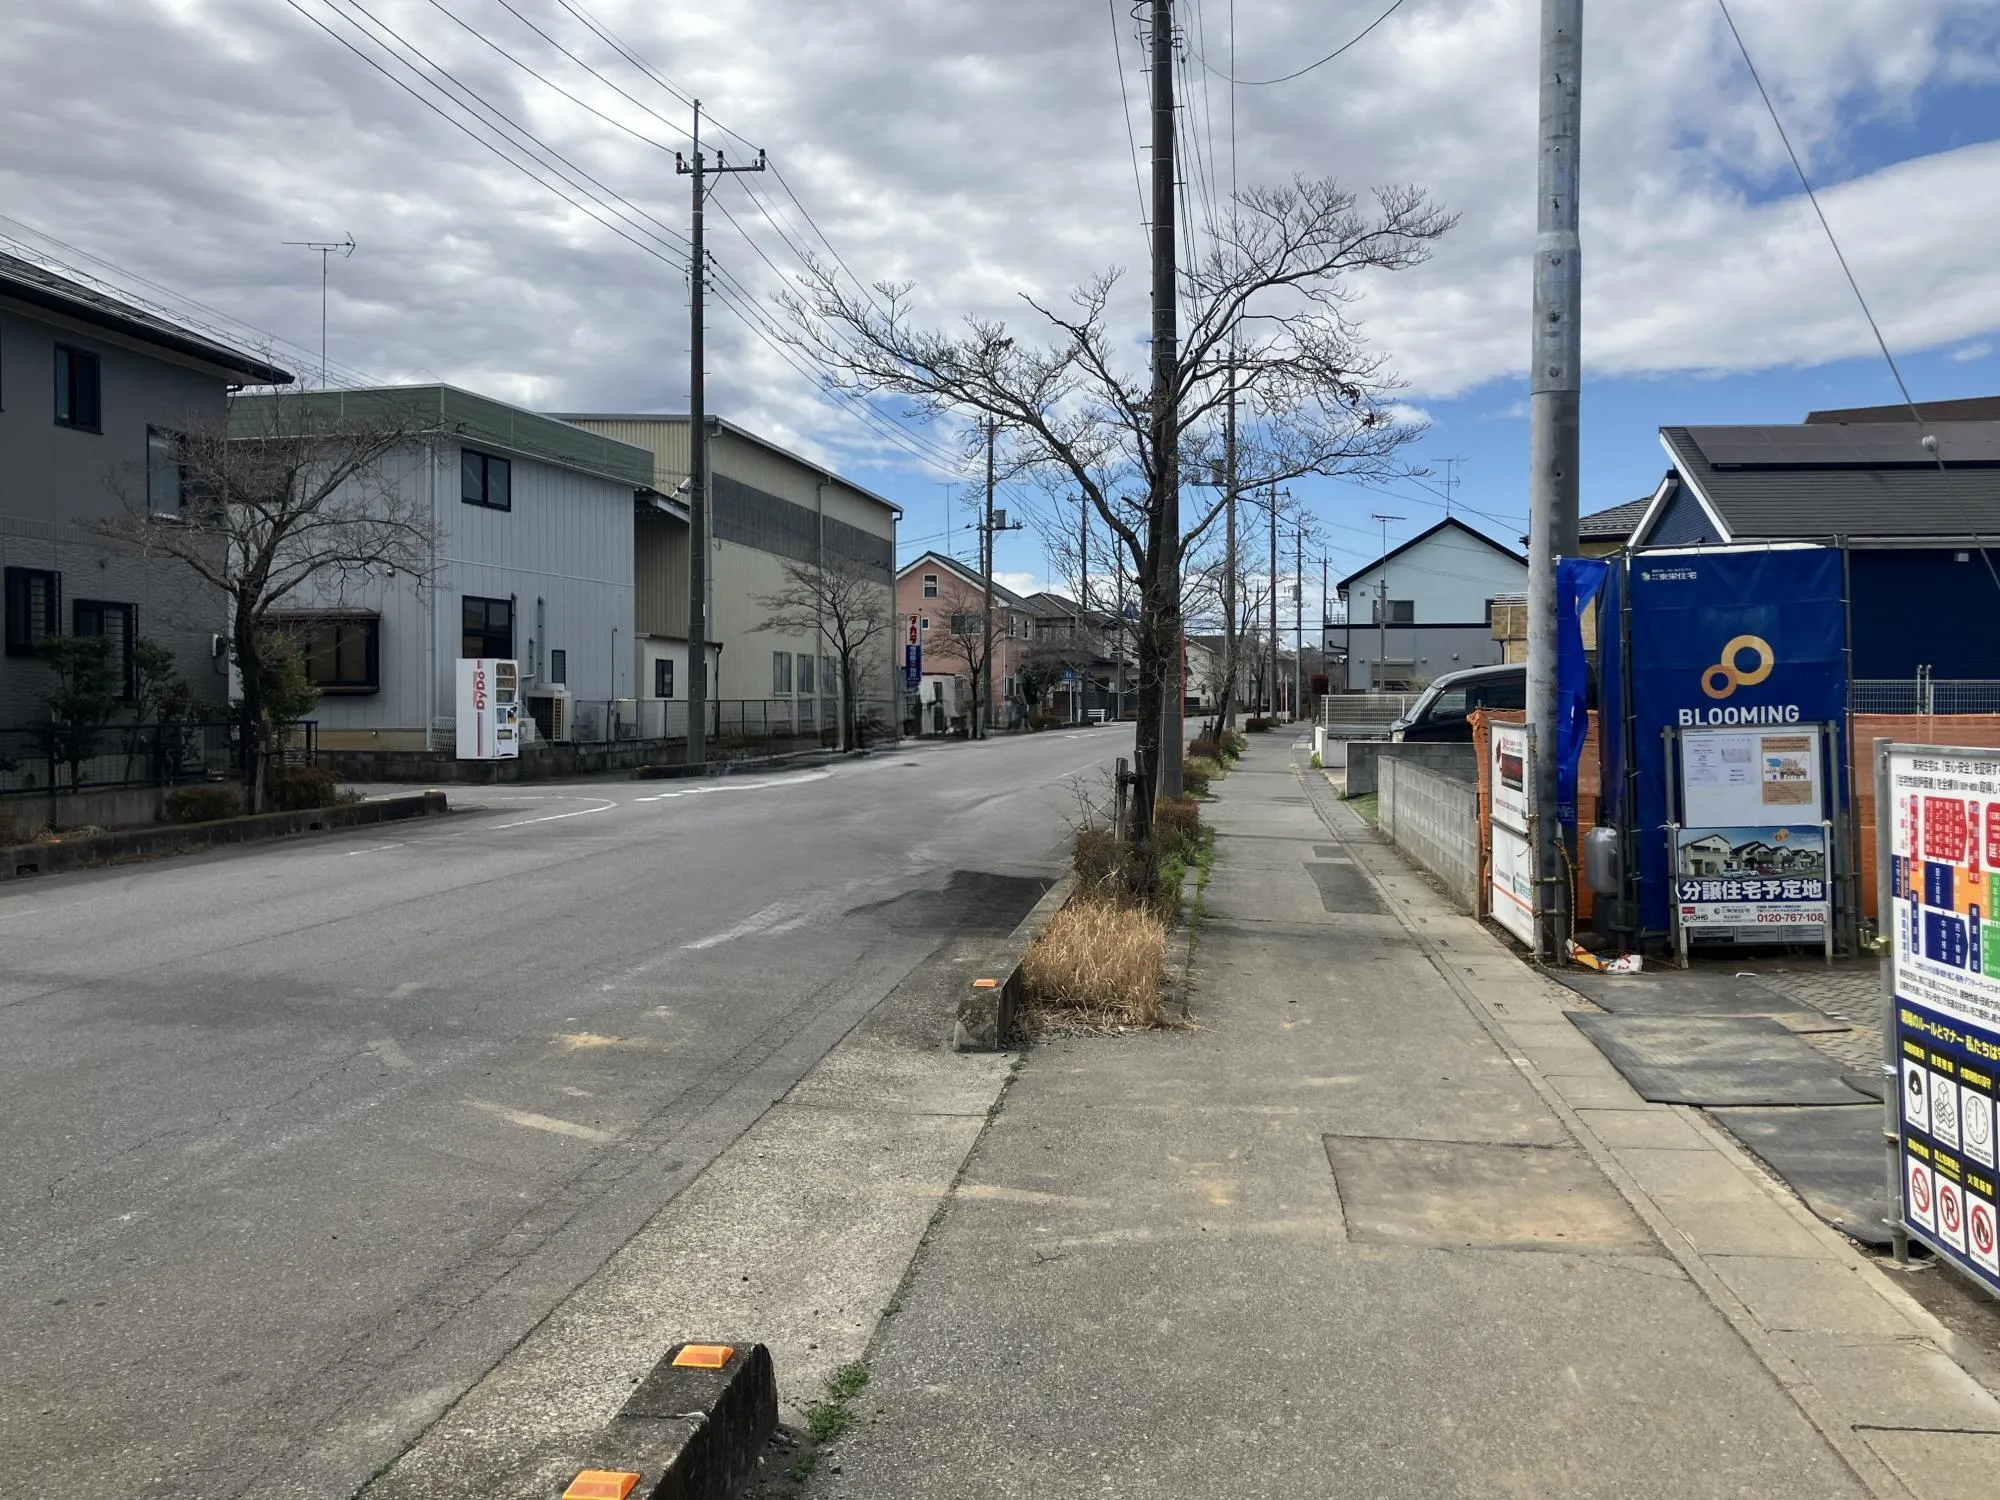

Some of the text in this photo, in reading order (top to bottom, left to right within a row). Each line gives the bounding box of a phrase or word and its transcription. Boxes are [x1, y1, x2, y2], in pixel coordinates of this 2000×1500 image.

[909, 615, 918, 645] タカラ
[476, 671, 487, 710] DyDo
[1678, 704, 1800, 726] BLOOMING
[1682, 879, 1823, 901] 分譲住宅予定地
[1757, 913, 1824, 923] 0120-767-108
